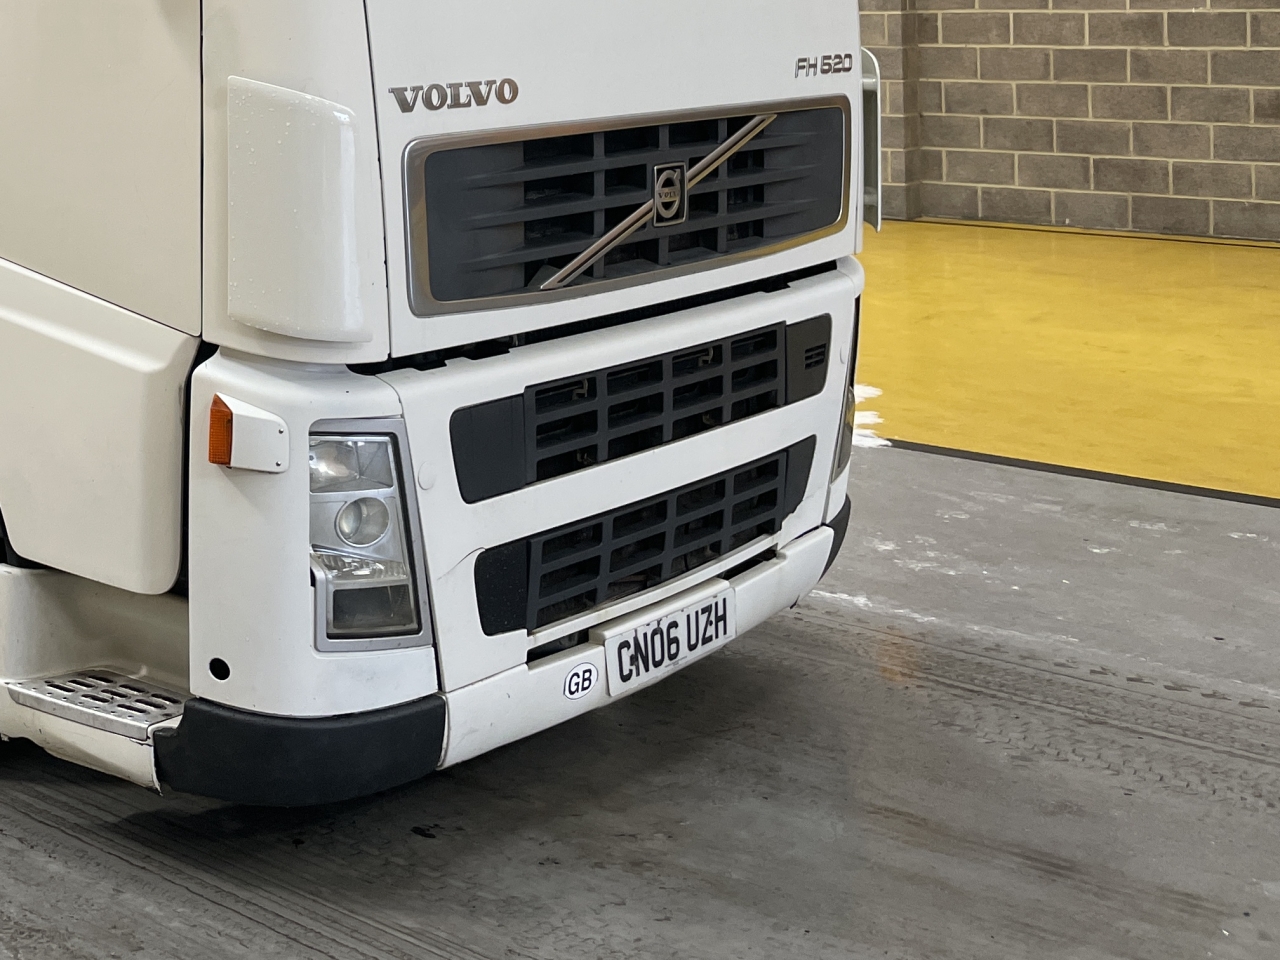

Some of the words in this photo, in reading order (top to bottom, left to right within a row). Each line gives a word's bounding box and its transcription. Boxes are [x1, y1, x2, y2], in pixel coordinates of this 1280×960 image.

[794, 56, 818, 79] FH
[820, 53, 853, 75] 520
[388, 78, 520, 114] VOLVO
[617, 620, 681, 683] CN06
[686, 597, 728, 652] UZH
[568, 668, 593, 696] GB
